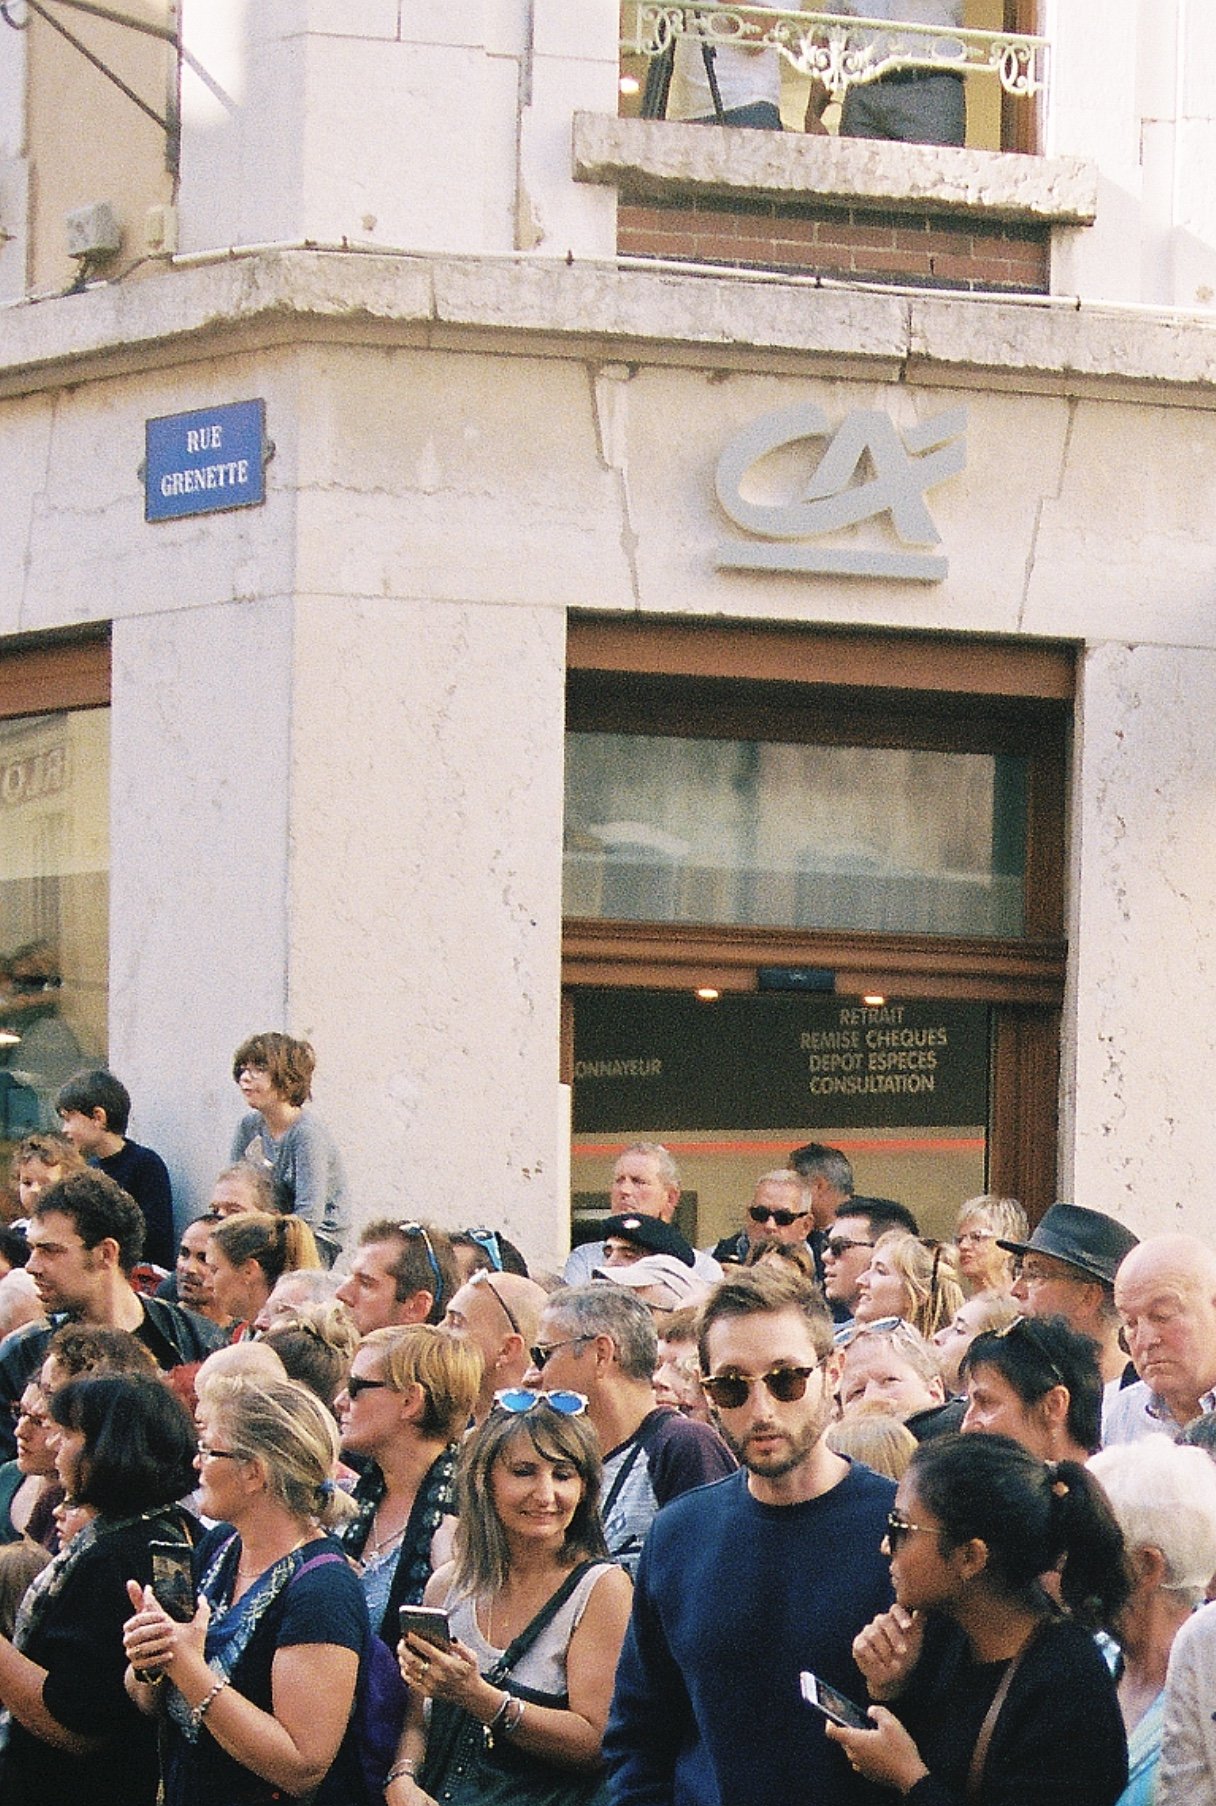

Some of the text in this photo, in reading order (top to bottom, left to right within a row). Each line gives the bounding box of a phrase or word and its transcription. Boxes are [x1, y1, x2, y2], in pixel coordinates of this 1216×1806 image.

[186, 425, 222, 453] RUE
[161, 459, 249, 497] GRENETTE
[839, 1006, 905, 1026] RETRAIT
[800, 1026, 948, 1050] REMISE CHEQUES
[575, 1058, 662, 1078] ONNAYEUR
[868, 1050, 938, 1071] ESPECES
[809, 1073, 935, 1095] CONSULTATION
